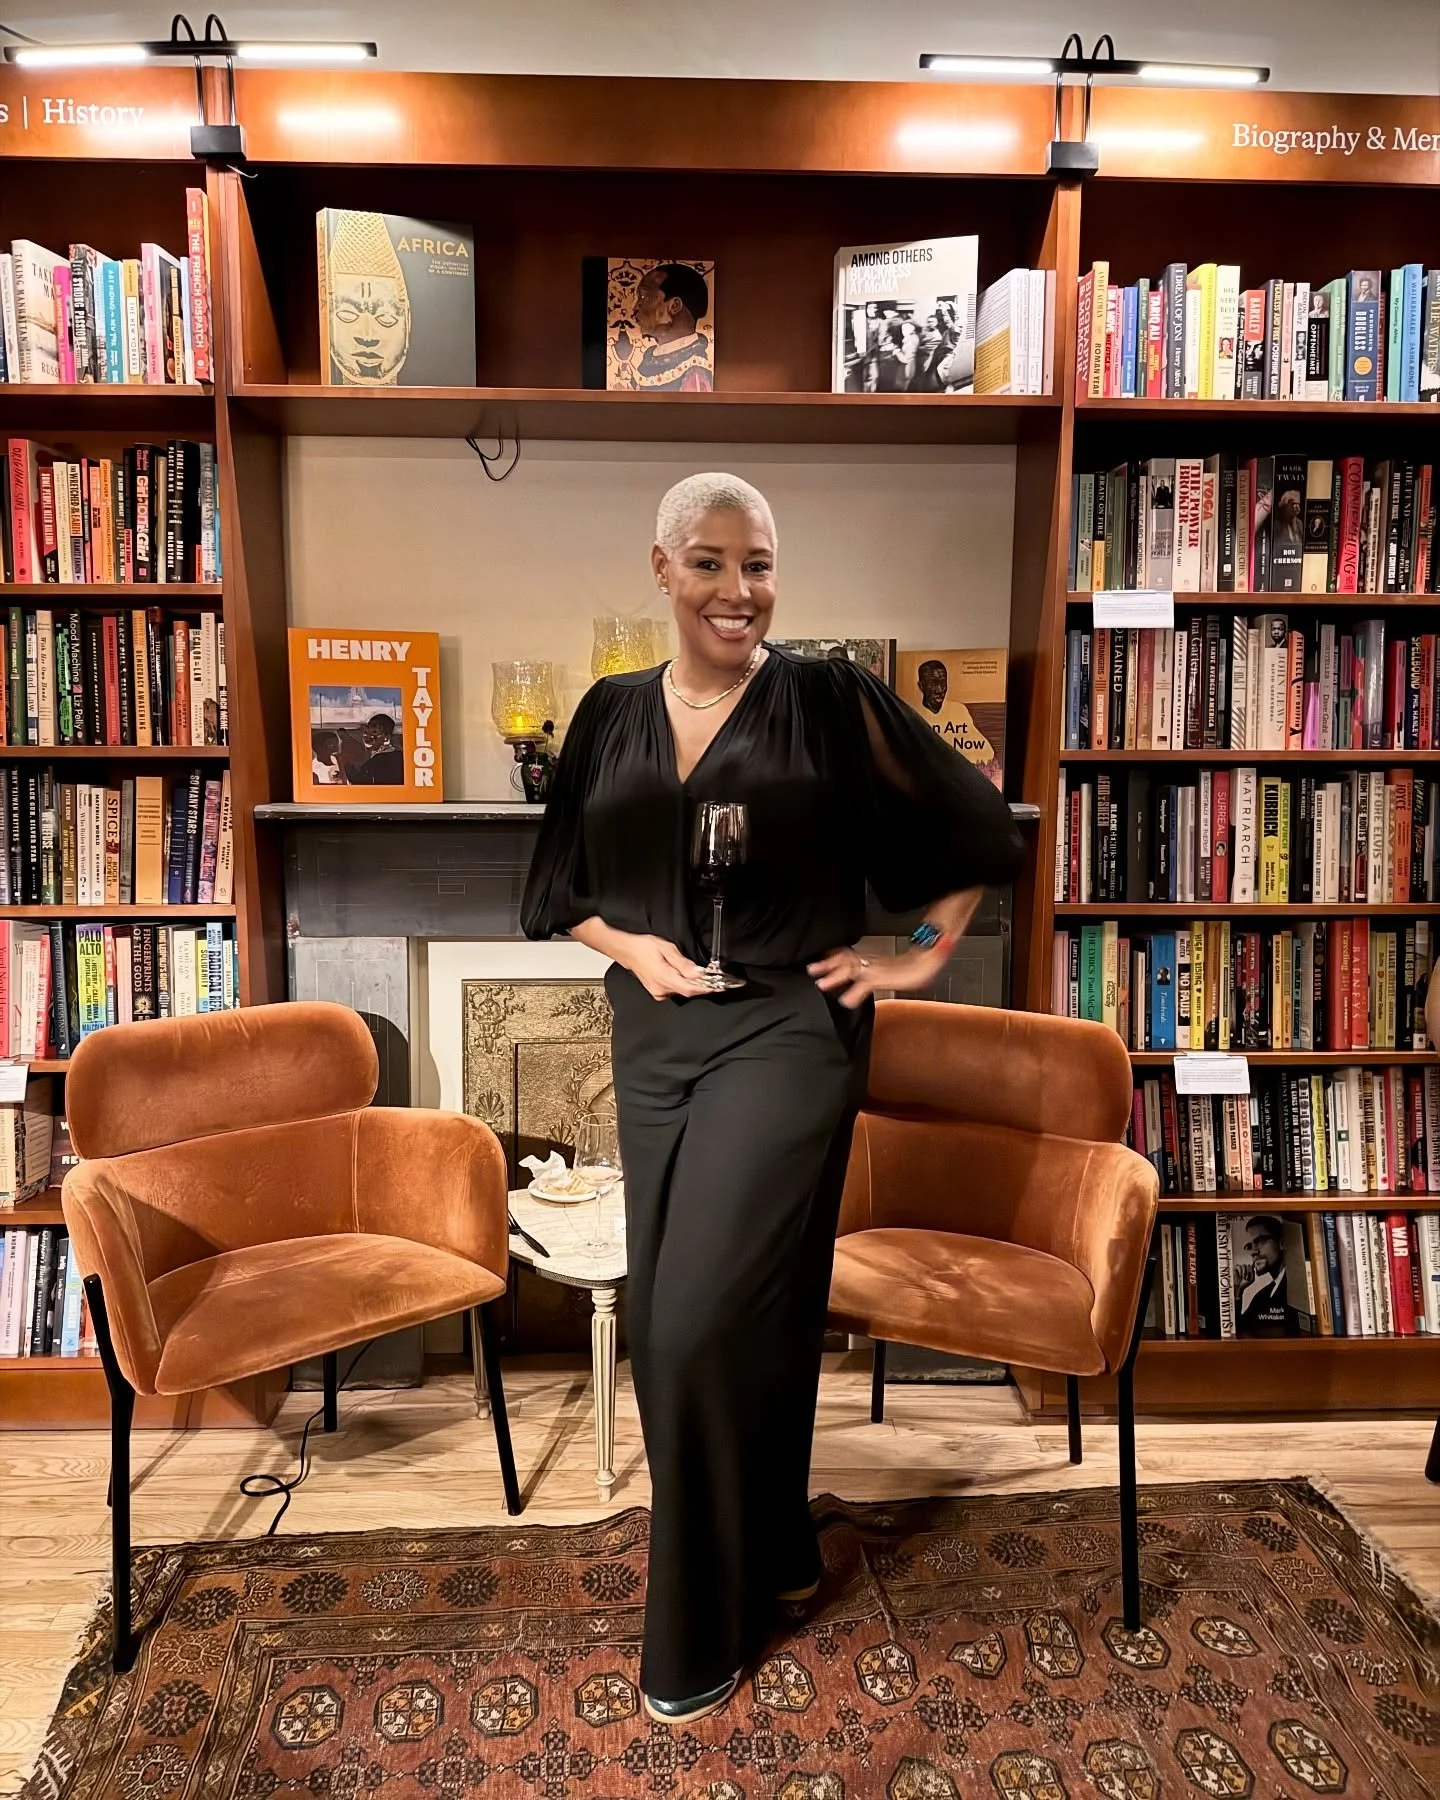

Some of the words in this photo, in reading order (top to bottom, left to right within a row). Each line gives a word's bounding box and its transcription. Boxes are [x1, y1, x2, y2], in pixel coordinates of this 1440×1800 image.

[42, 98, 145, 126] History
[1232, 123, 1361, 155] Biography
[1366, 126, 1386, 149] &
[191, 232, 200, 252] THE
[397, 237, 469, 258] AFRICA
[851, 251, 890, 269] AMONG
[892, 247, 933, 265] OTHERS
[192, 255, 202, 296] FRENCH
[72, 277, 85, 308] STRONG
[1175, 274, 1183, 307] DREAM
[1106, 310, 1116, 334] MOVE
[1149, 295, 1160, 324] TARIQ
[1174, 308, 1182, 322] OF
[1249, 297, 1261, 334] BARKLEY
[1409, 282, 1417, 335] WATERBEARERS
[73, 311, 86, 346] PASSIONS
[193, 298, 204, 349] DISPATCH
[1081, 279, 1093, 383] BIOGRAPHY
[1150, 324, 1160, 341] ALI
[1173, 321, 1182, 342] JONI
[1355, 311, 1367, 350] DOUGLASS
[1093, 342, 1102, 374] ROMAN
[1271, 342, 1280, 374] JOSEPHINE
[1427, 326, 1439, 372] WATERS
[1092, 376, 1100, 395] YEAR
[1270, 375, 1278, 395] BAKER
[12, 447, 23, 488] ORIGINAL
[1190, 463, 1201, 496] THE
[1277, 474, 1306, 482] TWAIN
[42, 488, 52, 508] PEOPLE
[70, 473, 80, 506] WRETCHED
[205, 477, 214, 529] COMPANY
[1179, 465, 1190, 523] BROKER
[1203, 478, 1214, 521] YOGA
[1334, 475, 1342, 523] BIBLIOPHOBIA
[1348, 463, 1361, 519] CONNIE
[1403, 489, 1411, 517] FUND
[43, 509, 53, 523] NEED
[1098, 503, 1104, 515] ON
[1189, 498, 1200, 548] POWER
[44, 524, 54, 545] KILLING
[71, 514, 80, 535] EARTH
[73, 538, 81, 556] FRANTZ
[137, 532, 149, 562] Girl
[1344, 522, 1360, 575] CHUNG
[69, 613, 79, 640] Mood
[118, 616, 126, 645] BLACK
[1191, 617, 1202, 634] Ina
[175, 629, 185, 662] Calling
[193, 636, 201, 660] COLOR
[307, 638, 411, 662] HENRY
[1190, 637, 1202, 675] Garten
[1296, 636, 1304, 655] THE
[71, 643, 81, 683] Machine
[136, 650, 144, 688] DEMOCRACY
[193, 667, 202, 682] LAW
[1278, 654, 1286, 686] JOHN
[1411, 636, 1421, 689] SPELLBOUND
[28, 692, 37, 712] Law
[73, 694, 82, 707] Liz
[121, 700, 129, 727] REEVE
[137, 690, 146, 730] AWAKENING
[219, 690, 227, 710] BLACK
[1276, 692, 1286, 732] LEWIS
[74, 709, 84, 730] Pelly
[220, 710, 228, 730] MEME
[412, 667, 435, 787] TAYLOR
[944, 721, 968, 734] Art
[953, 737, 985, 750] Now
[190, 775, 200, 785] SO
[1359, 775, 1368, 794] FROM
[189, 786, 200, 809] MANY
[1264, 784, 1278, 838] KUBRICK
[1359, 795, 1368, 815] THESE
[1374, 777, 1382, 822] BEFORE
[1396, 784, 1406, 811] JOYCE
[1414, 779, 1425, 822] WARHOL'S
[42, 811, 53, 822] WE
[107, 798, 118, 838] SPICE
[187, 810, 198, 834] STARS
[222, 796, 230, 833] NATIONS
[1217, 791, 1226, 837] SURREAL
[1241, 774, 1252, 865] MATRIARCH
[1359, 816, 1368, 838] ROOTS
[42, 823, 54, 849] REFUSE
[1373, 826, 1382, 860] ELVIS
[79, 930, 101, 943] PALO
[133, 928, 141, 942] OF
[158, 929, 167, 942] KING
[1088, 931, 1096, 948] THE
[1194, 934, 1202, 951] HIGH
[1406, 928, 1414, 945] WHAT
[79, 943, 102, 956] ALTO
[144, 928, 152, 992] FINGERPRINTS
[159, 943, 168, 973] LEOPOLD'S
[1088, 948, 1096, 975] LYRICS
[133, 964, 142, 992] GODS
[160, 972, 168, 991] GHOST
[208, 950, 222, 993] RADICAL
[1087, 977, 1095, 994] Paul
[1181, 972, 1190, 988] NO
[1194, 962, 1202, 985] RISING
[1351, 946, 1361, 1020] BARNEYS
[1405, 970, 1413, 986] DARK
[1180, 989, 1190, 1019] FAULT
[57, 1003, 66, 1038] RESISTANCE
[1191, 1108, 1201, 1133] SLATE
[1366, 1125, 1374, 1143] DREAM
[1397, 1117, 1406, 1175] TOURMALINE
[1218, 1234, 1228, 1250] SAY
[1391, 1226, 1409, 1257] WAR
[1220, 1266, 1231, 1298] NAOMI
[1221, 1300, 1233, 1329] WATTS
